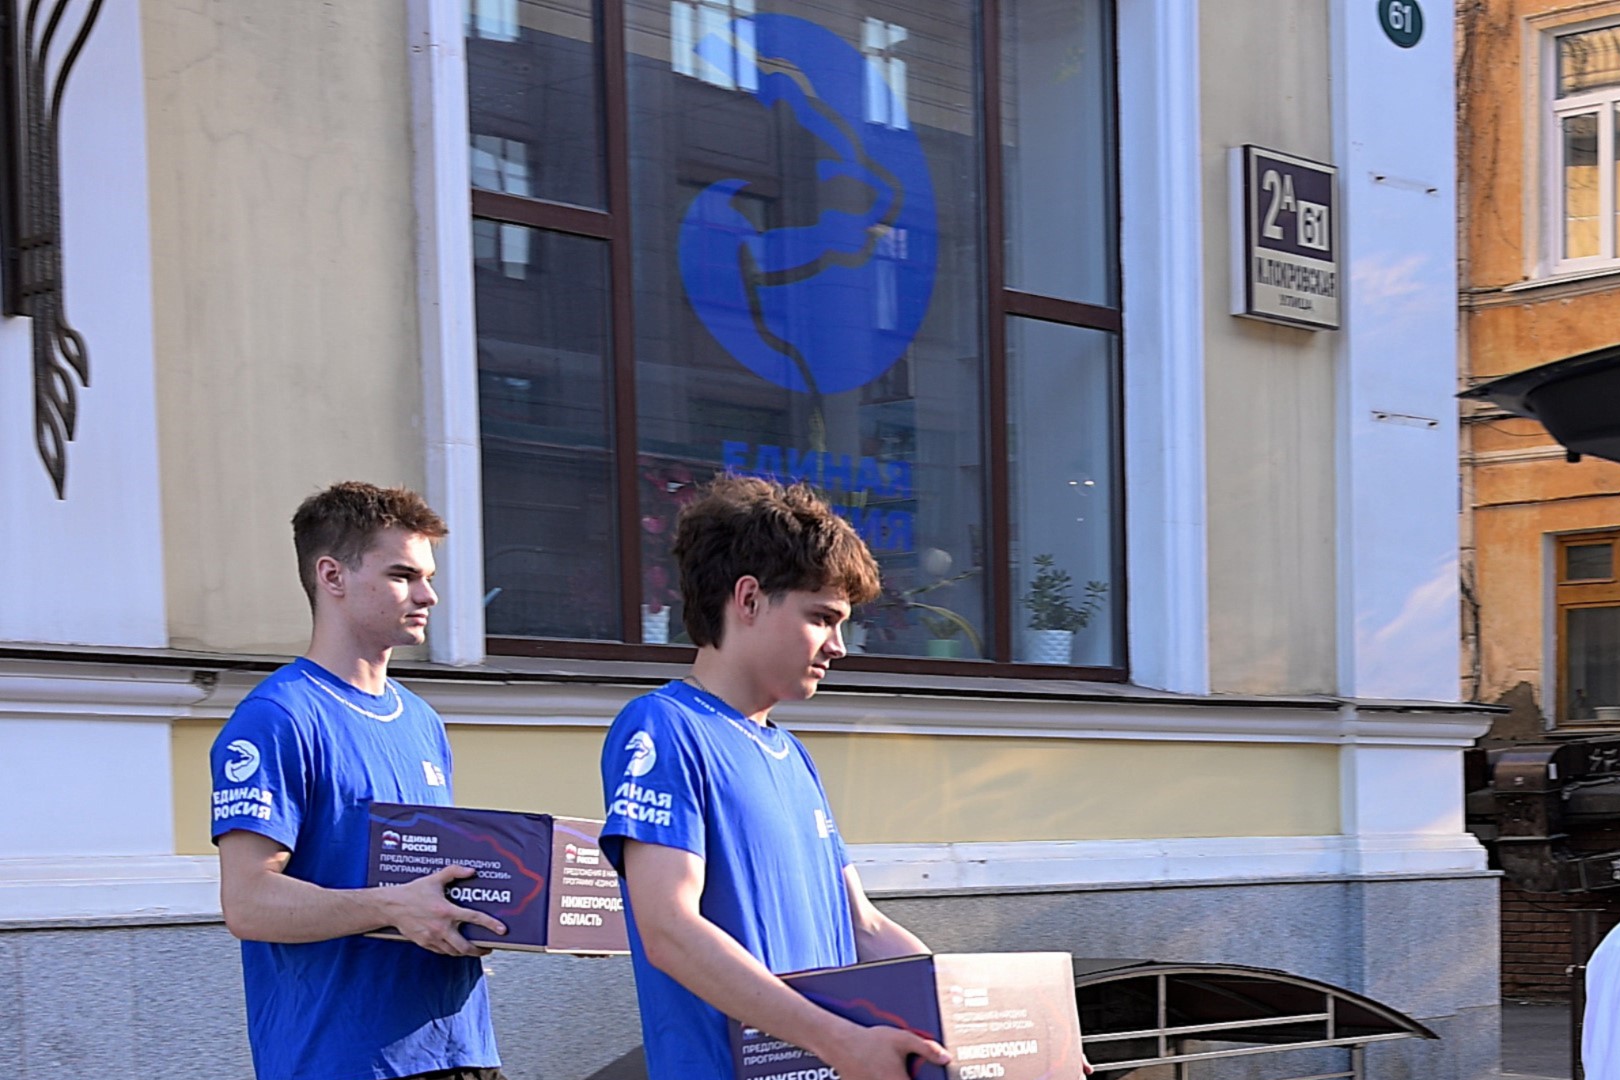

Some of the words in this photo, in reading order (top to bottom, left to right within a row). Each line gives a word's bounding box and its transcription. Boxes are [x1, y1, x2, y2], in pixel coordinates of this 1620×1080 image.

[1389, 1, 1412, 33] 61
[1303, 206, 1328, 248] 61
[722, 440, 912, 498] ЕДИНАЯ
[213, 786, 273, 806] ЕДИНАЯ
[614, 782, 672, 809] ИНАЯ
[213, 801, 272, 821] РОССИЯ
[607, 799, 671, 827] ССИЯ
[401, 834, 438, 844] ЕДИНАЯ
[401, 843, 437, 852] РОССИЯ
[380, 854, 443, 865] ПРЕДЛОЖЕНИЯ
[453, 859, 501, 869] НАРОДНУЮ
[380, 863, 431, 874] ПРОГРАММУ
[561, 895, 624, 911] НИЖЕГОРОДС
[560, 913, 602, 926] ОБЛАСТЬ
[744, 1050, 803, 1066] ПРОГРАММУ
